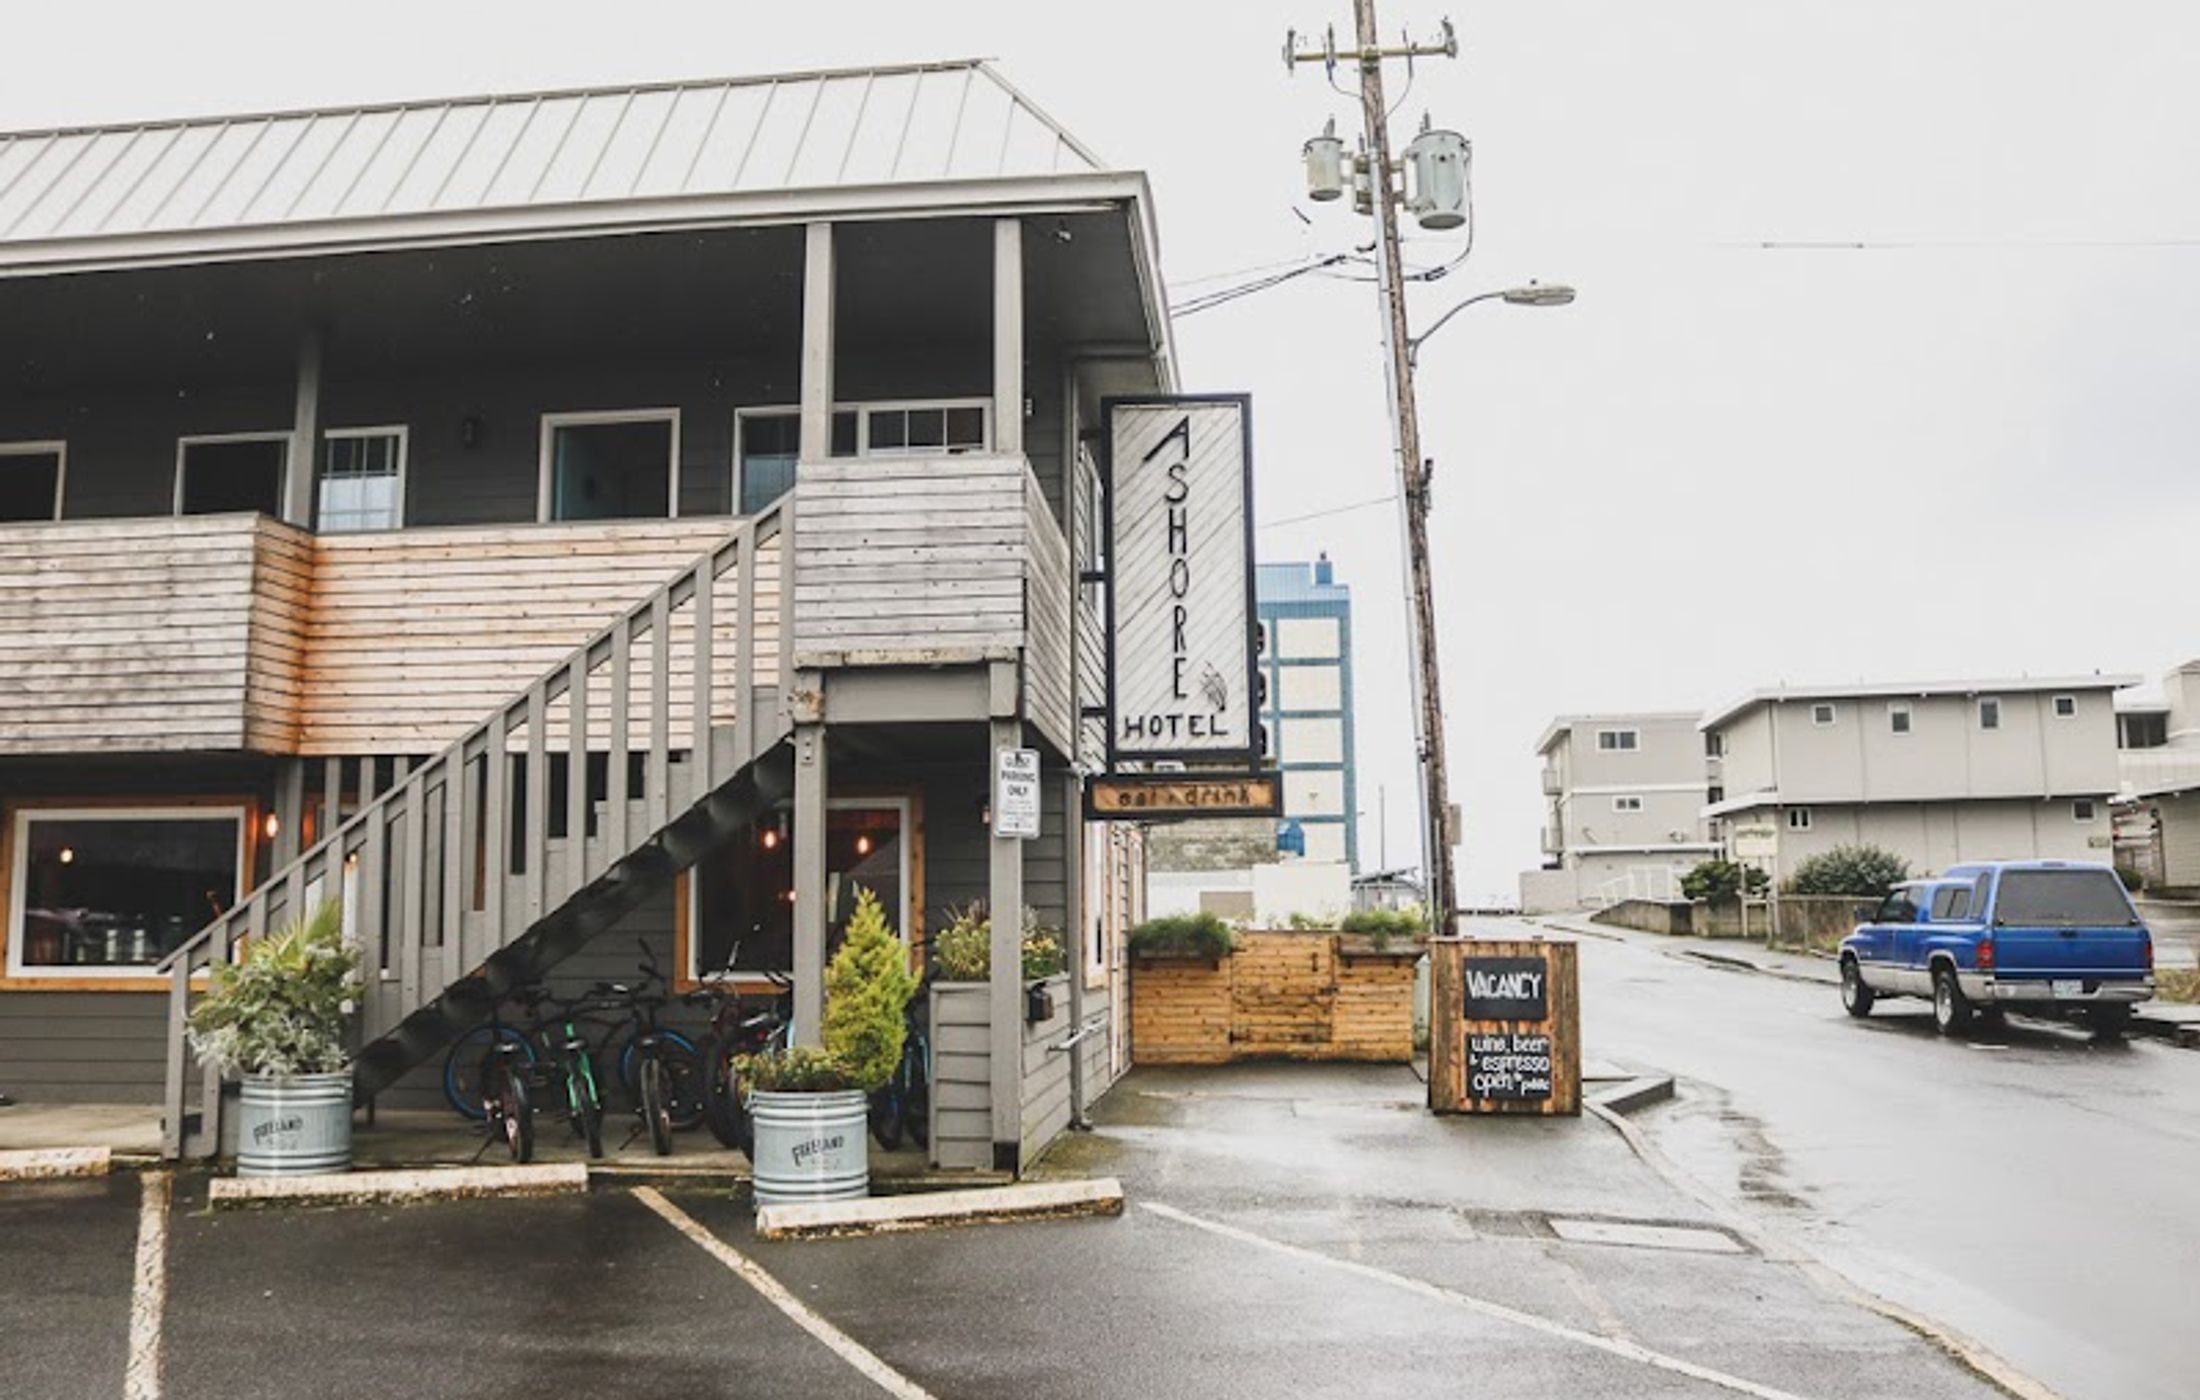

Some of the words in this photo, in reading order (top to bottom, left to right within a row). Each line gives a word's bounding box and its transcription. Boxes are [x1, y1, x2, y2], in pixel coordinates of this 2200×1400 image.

[1142, 415, 1190, 699] ASHORE
[1124, 713, 1229, 738] HOTEL
[1001, 770, 1036, 782] PARKING
[1007, 784, 1028, 796] ONLY
[1185, 783, 1250, 807] drink
[1466, 970, 1542, 999] VACANCY
[1513, 1034, 1549, 1052] beer
[1482, 1055, 1549, 1075] espresso
[1473, 1072, 1514, 1097] open
